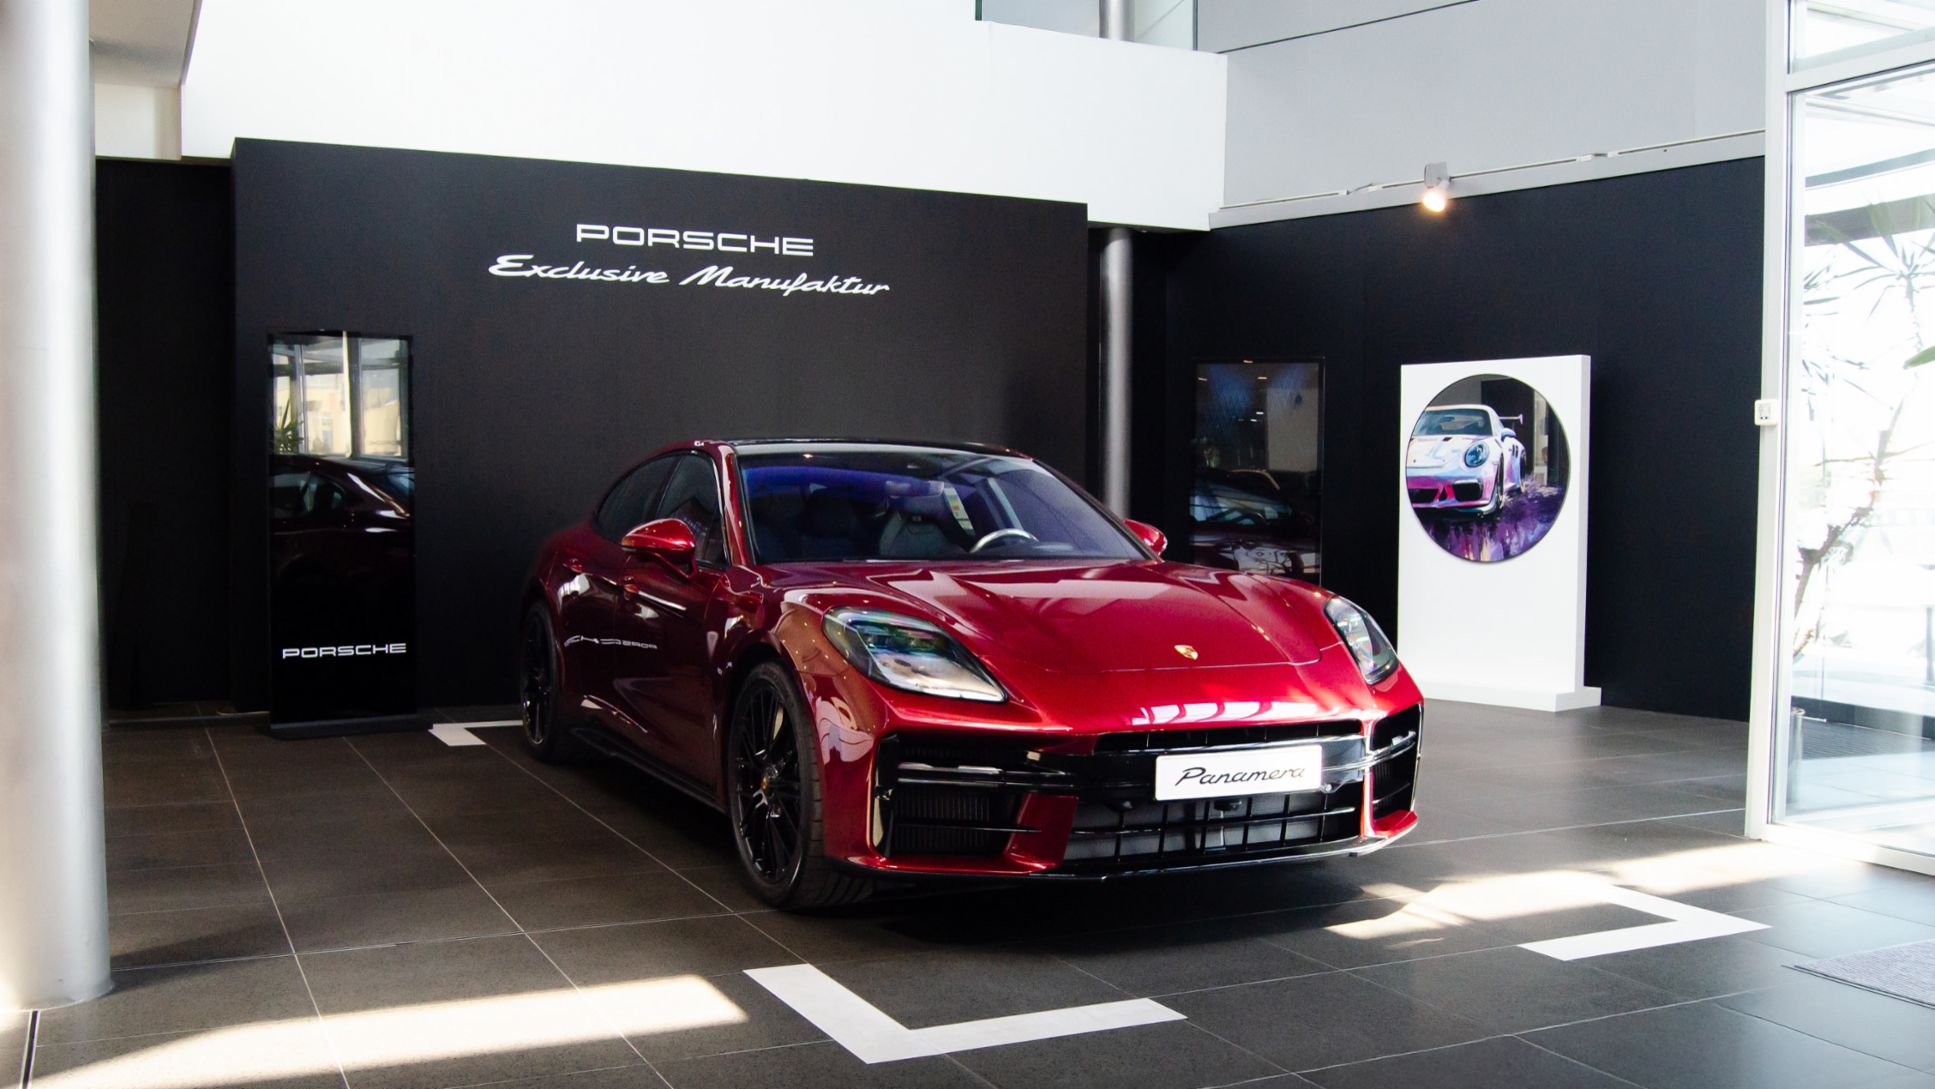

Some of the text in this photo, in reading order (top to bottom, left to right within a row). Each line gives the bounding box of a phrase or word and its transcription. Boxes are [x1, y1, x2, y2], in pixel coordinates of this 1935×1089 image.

[576, 223, 814, 256] PORSCHE
[487, 254, 891, 296] Exclusive Manufaktur
[282, 642, 407, 659] PORSCHE
[1174, 766, 1305, 787] Panamera
